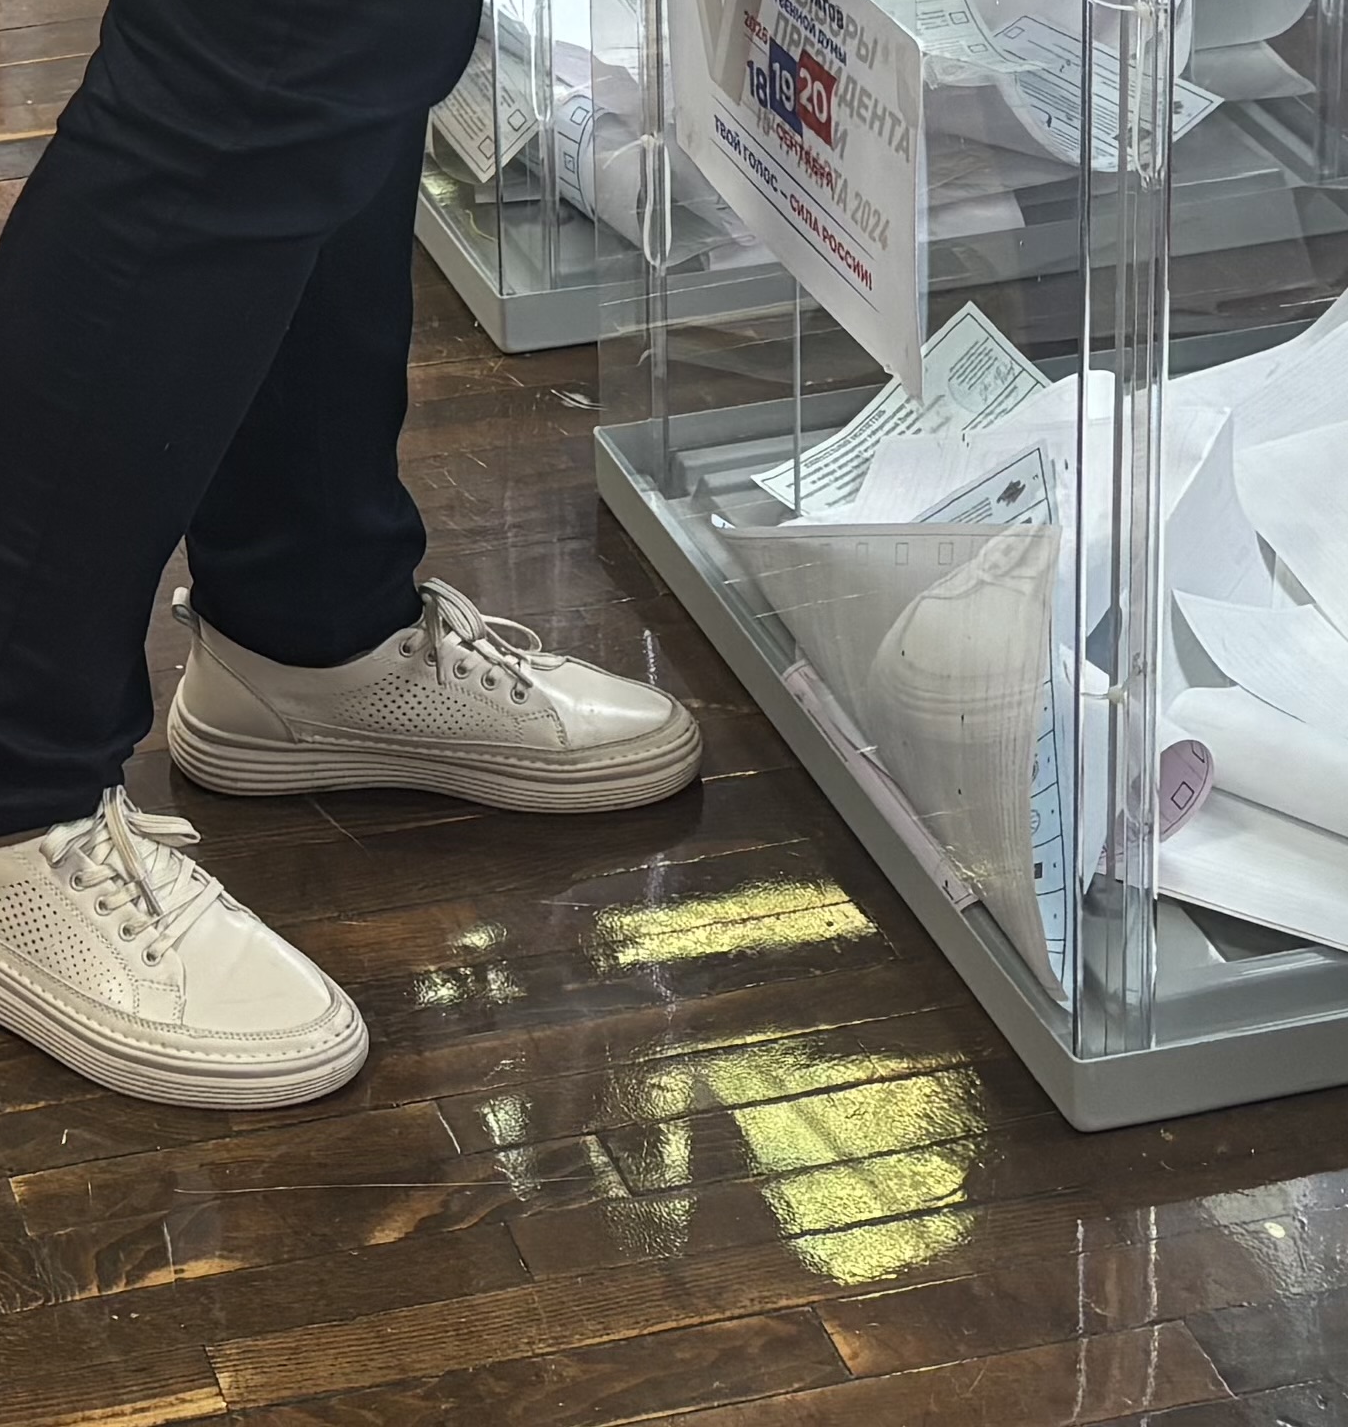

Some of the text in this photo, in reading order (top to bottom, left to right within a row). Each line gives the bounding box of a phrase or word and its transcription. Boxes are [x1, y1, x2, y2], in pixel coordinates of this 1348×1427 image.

[816, 28, 848, 67] ДУМЫ
[747, 60, 828, 125] 18 19 20
[714, 114, 742, 156] ТВОЙ
[742, 146, 779, 193] ГОЛОС
[789, 193, 821, 238] СИЛА
[821, 224, 873, 292] РОССИИ!
[851, 189, 890, 251] 2024
